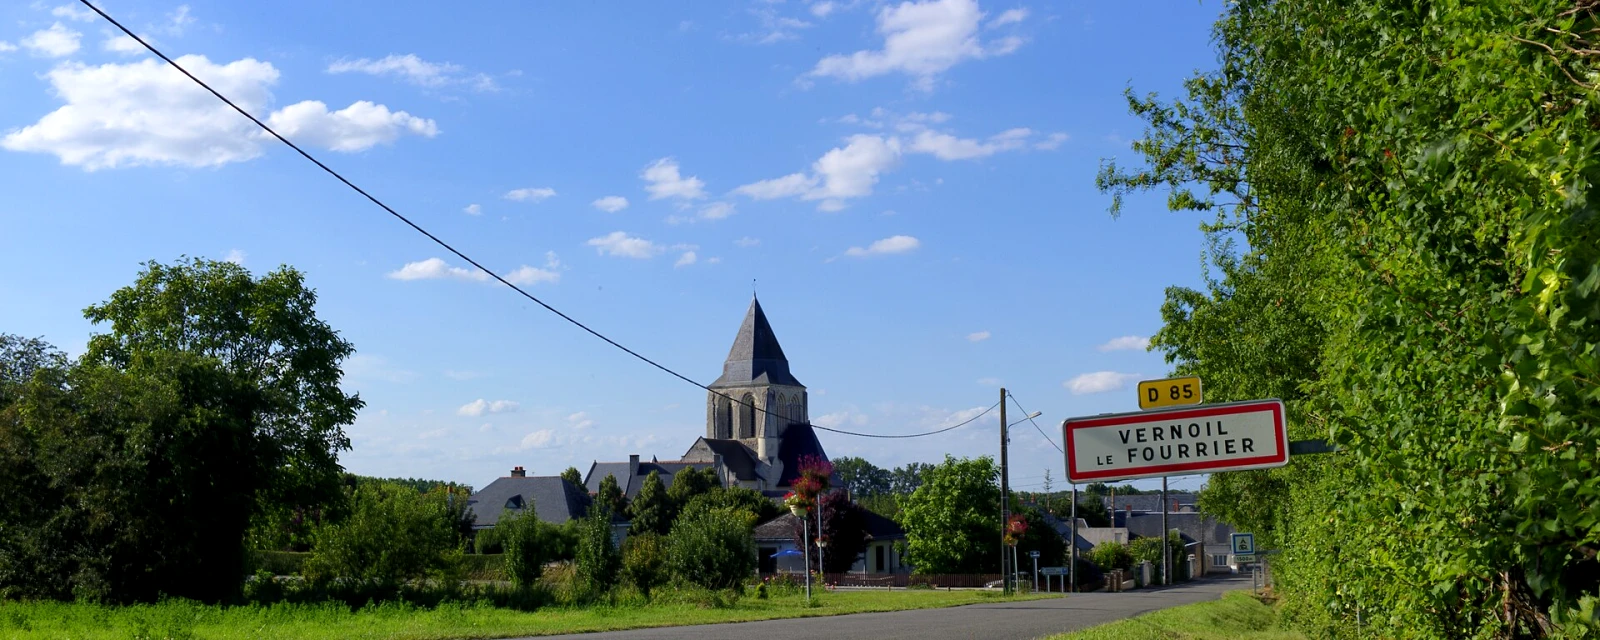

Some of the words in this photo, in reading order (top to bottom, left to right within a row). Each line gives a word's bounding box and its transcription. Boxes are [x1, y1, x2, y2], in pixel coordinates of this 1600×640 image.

[1148, 388, 1159, 402] D
[1170, 384, 1193, 400] 85
[1119, 421, 1228, 444] VERNOIL
[1097, 455, 1113, 465] LE
[1128, 438, 1254, 463] FOURRIER
